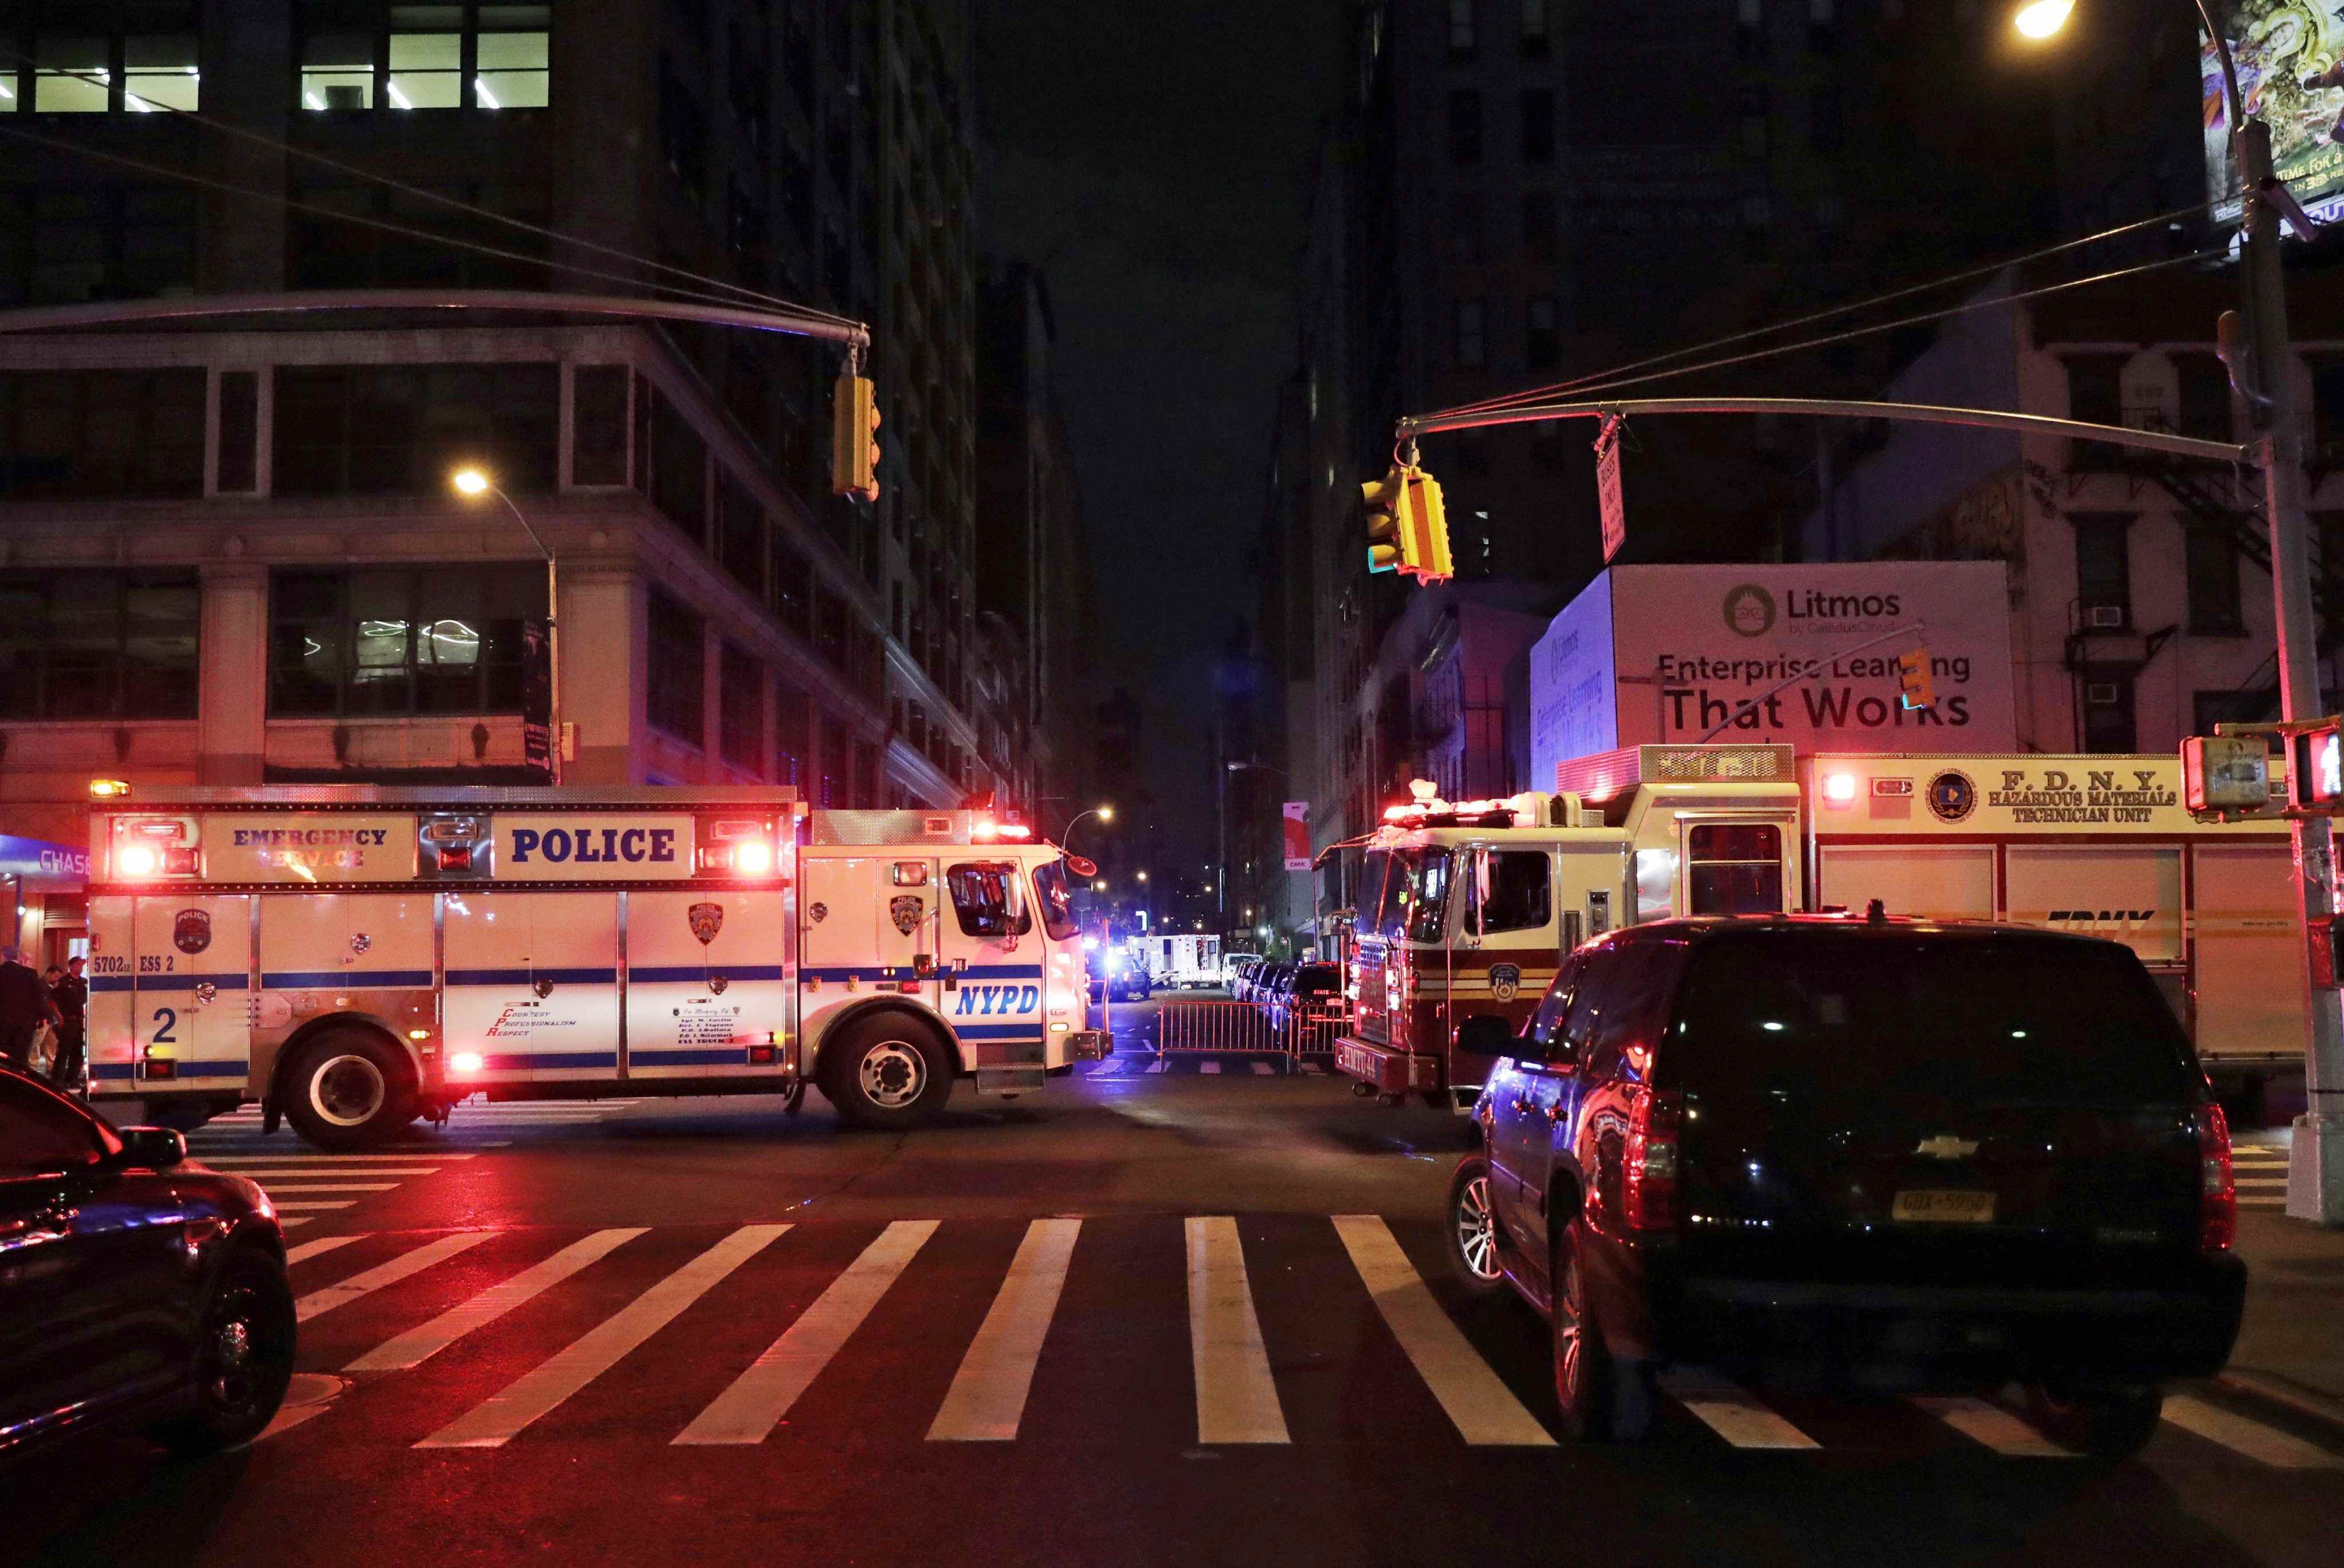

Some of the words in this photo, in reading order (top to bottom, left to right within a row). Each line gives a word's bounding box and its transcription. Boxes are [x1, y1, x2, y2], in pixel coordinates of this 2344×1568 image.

[1788, 590, 1900, 619] Litmos
[1658, 654, 1820, 686] Enterprise
[1664, 689, 1783, 730] That
[1988, 791, 2083, 806] HAZARDOUS
[2088, 791, 2177, 806] MATERIALS
[2013, 807, 2109, 823] TECHNICIAN
[2113, 807, 2152, 822] UNIT
[234, 830, 387, 846] EMERGENCY
[512, 829, 675, 862] POLICE
[178, 911, 208, 924] POLICE
[2046, 910, 2156, 934] FDNY
[94, 956, 124, 972] 5702
[140, 956, 161, 972] ESS
[167, 956, 173, 971] 2
[955, 985, 1039, 1015] NYPD
[153, 1008, 176, 1043] 2
